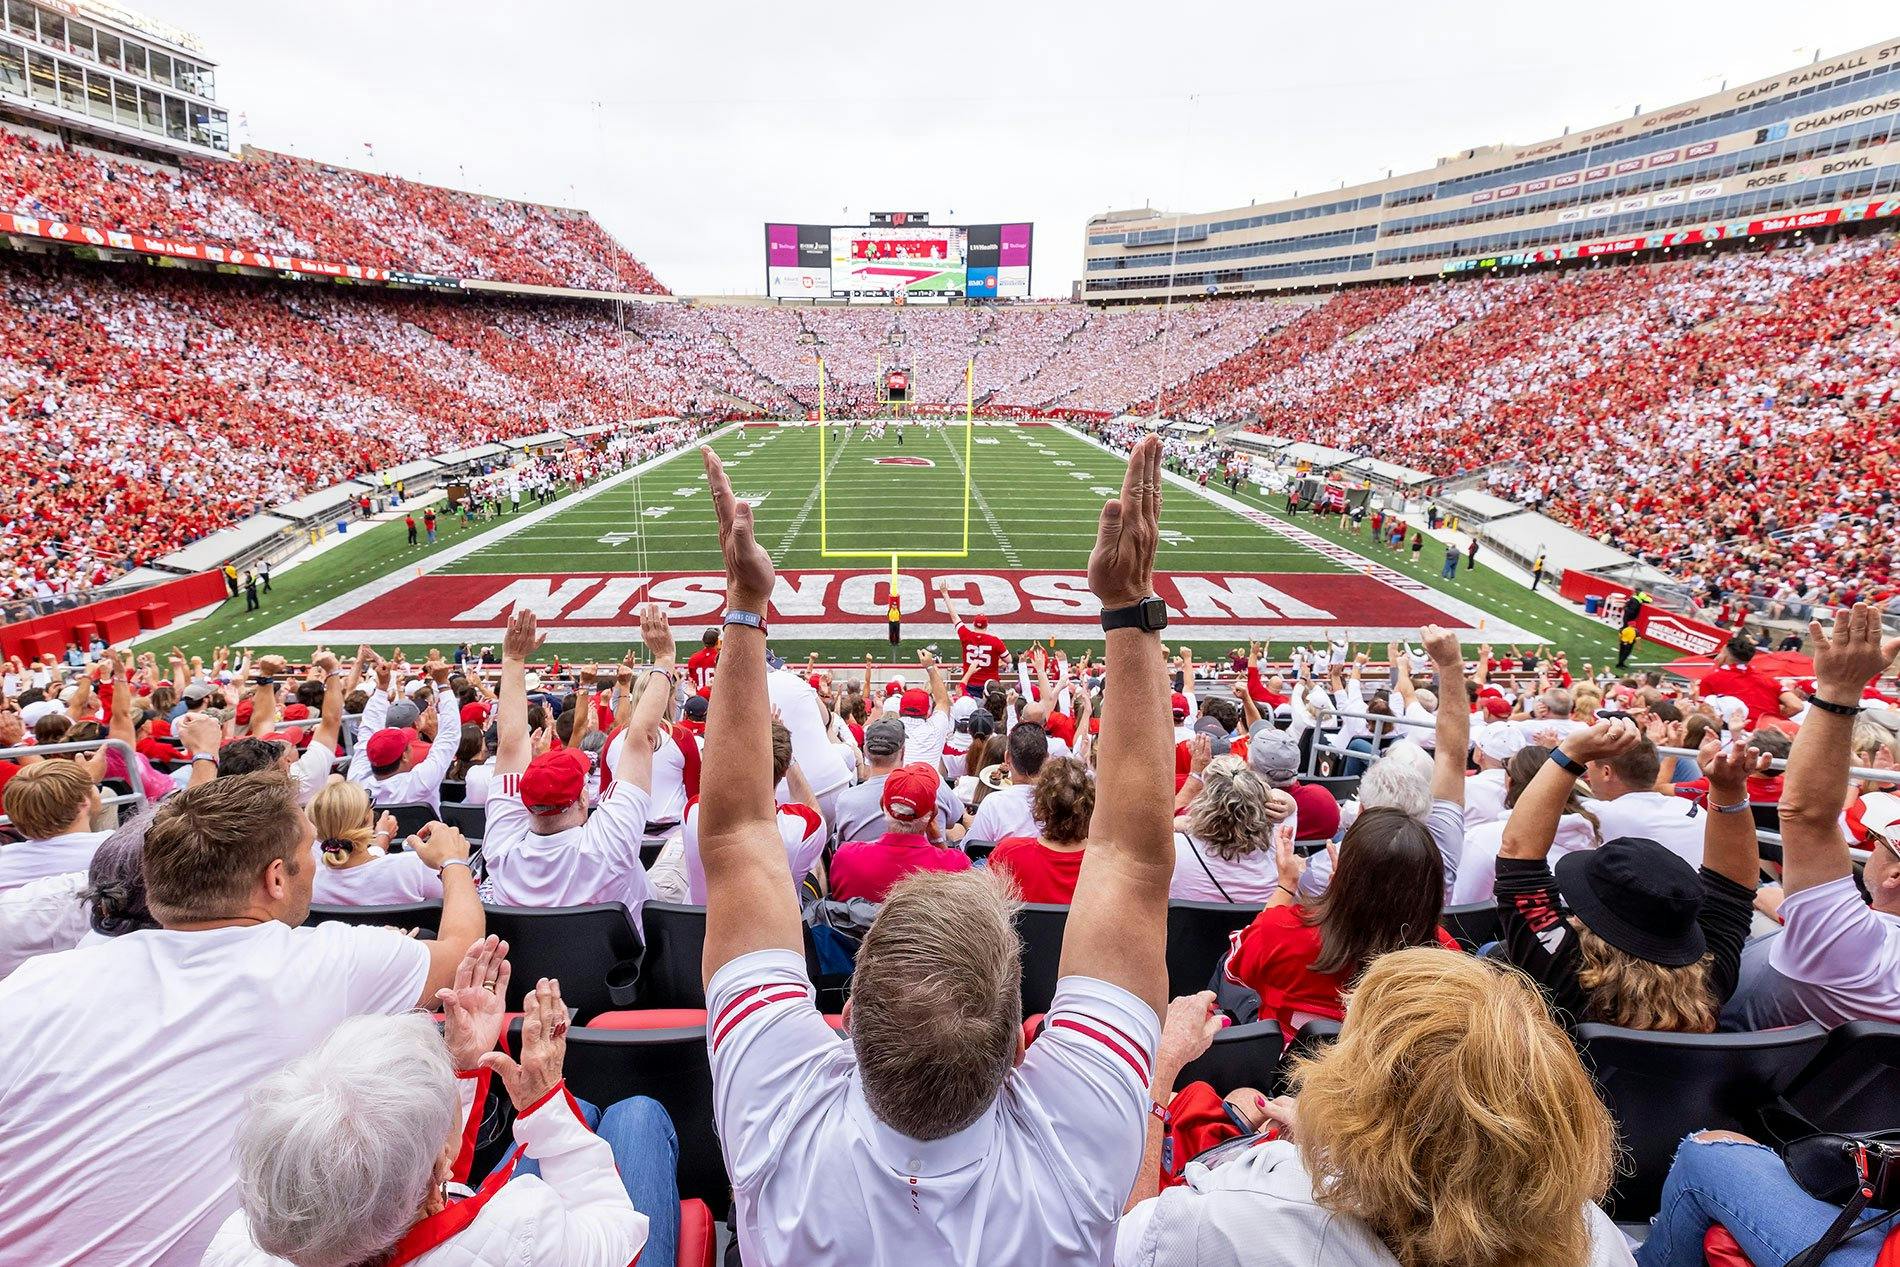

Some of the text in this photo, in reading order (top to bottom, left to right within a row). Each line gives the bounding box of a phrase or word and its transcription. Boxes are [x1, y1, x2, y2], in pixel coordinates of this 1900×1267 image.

[1737, 82, 1780, 102] CAMP
[1788, 56, 1867, 86] RANDALL
[1794, 98, 1900, 133] CHAMPIONS
[1745, 156, 1873, 189] ROSE BOWL
[1762, 212, 1828, 231] Take A Seat!
[166, 242, 175, 253] A
[1588, 244, 1606, 254] Take
[1606, 242, 1614, 252] A
[450, 573, 1338, 622] WSCONSIN
[966, 644, 992, 667] 25
